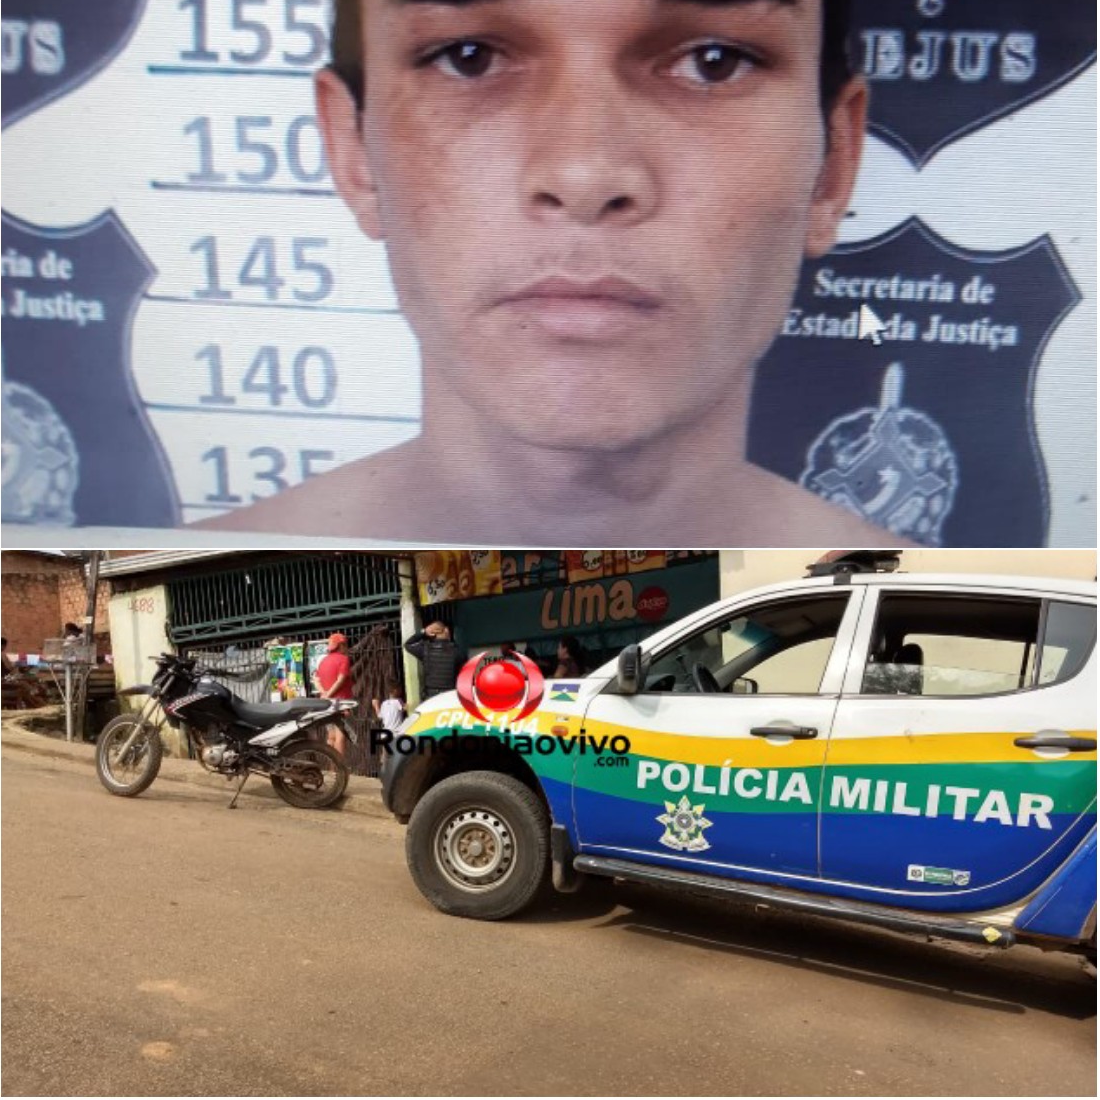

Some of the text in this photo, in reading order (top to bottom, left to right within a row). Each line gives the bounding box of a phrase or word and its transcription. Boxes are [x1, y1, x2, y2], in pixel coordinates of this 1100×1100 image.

[861, 29, 1036, 83] EJUS
[183, 115, 328, 183] 150
[39, 251, 73, 279] de
[190, 236, 333, 301] 145
[813, 268, 995, 304] Secretaria de
[12, 291, 106, 325] Justiça
[781, 309, 1020, 350] Estad da Justiça
[195, 344, 338, 408] 140
[541, 580, 637, 630] Lima
[637, 759, 1054, 830] POLÍCIA MILITAR
